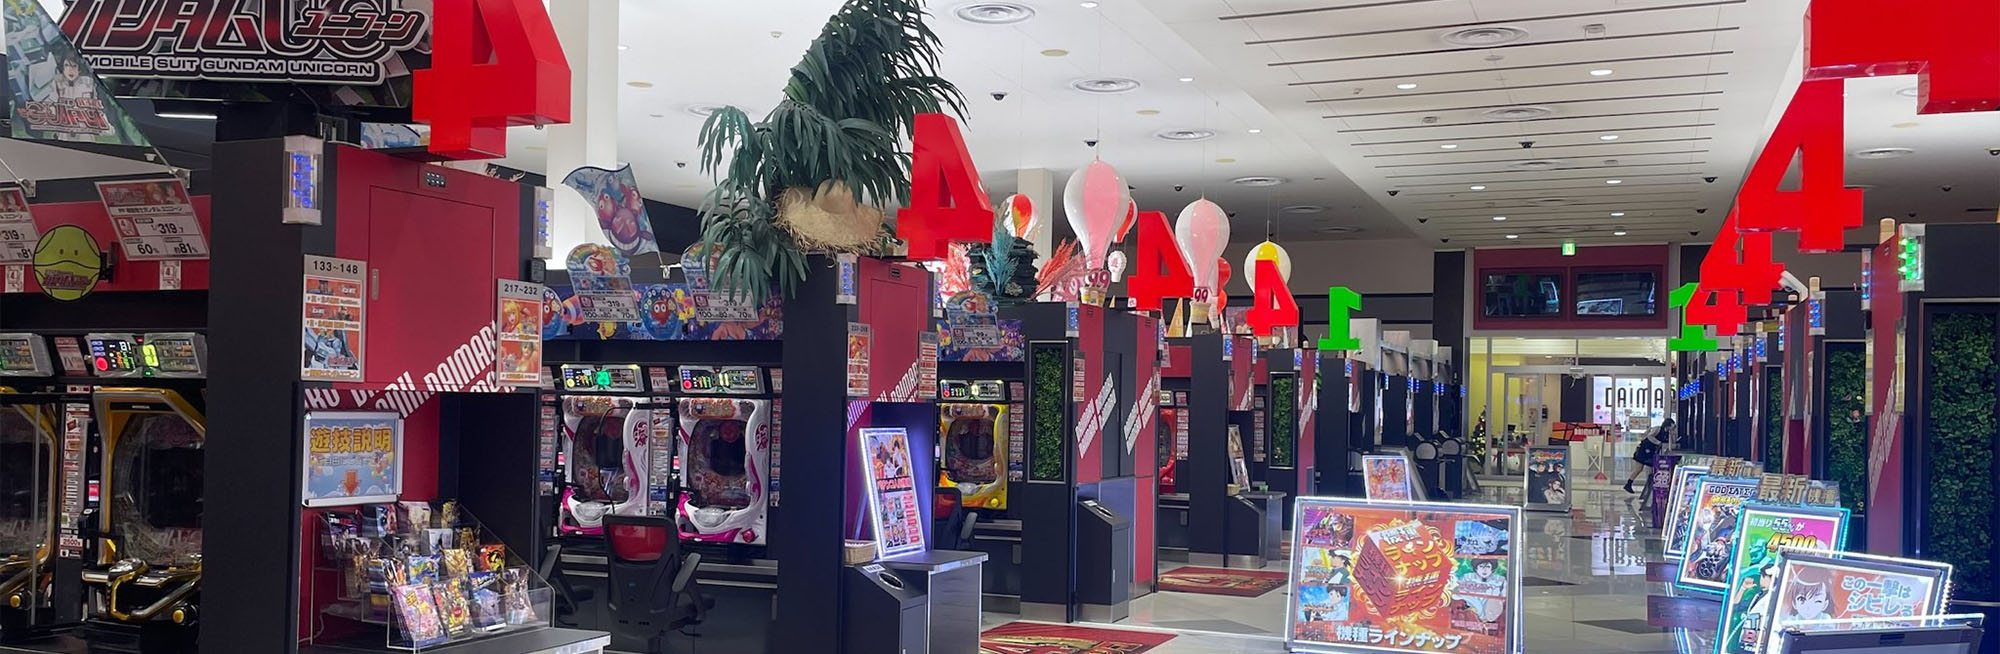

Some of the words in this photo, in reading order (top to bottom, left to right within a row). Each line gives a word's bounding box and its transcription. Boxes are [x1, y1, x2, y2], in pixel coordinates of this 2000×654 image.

[86, 57, 150, 69] MOBILE
[157, 59, 197, 71] SUIT
[203, 60, 283, 73] GUNDAM
[290, 63, 373, 76] UNICORN
[1735, 76, 1863, 253] 4
[1699, 203, 1785, 306] 4
[1668, 282, 1718, 351] 1
[1685, 284, 1748, 336] 4
[311, 427, 392, 453] 遊技説明
[1841, 575, 1912, 599] この一撃は
[1847, 591, 1914, 617] シビレる
[1336, 624, 1463, 650] 機種ラインナップ
